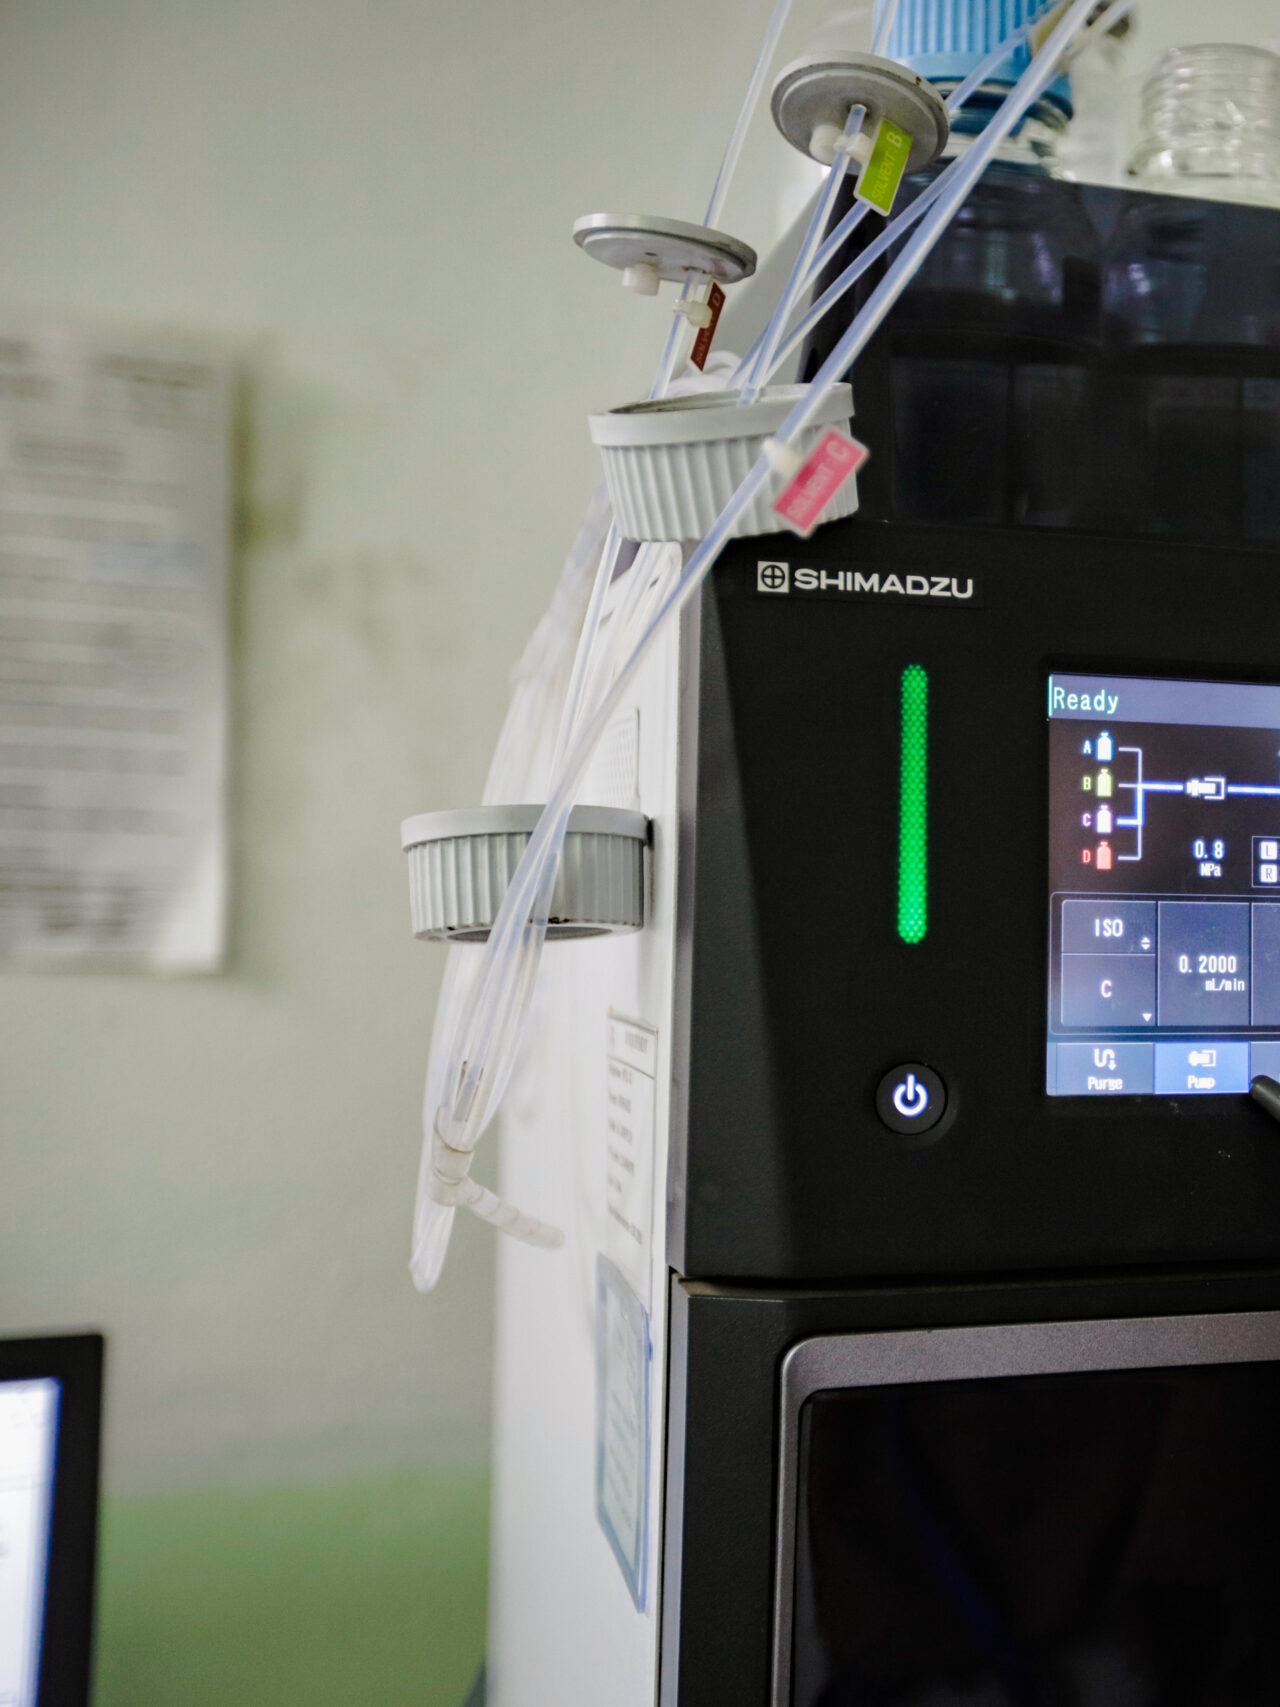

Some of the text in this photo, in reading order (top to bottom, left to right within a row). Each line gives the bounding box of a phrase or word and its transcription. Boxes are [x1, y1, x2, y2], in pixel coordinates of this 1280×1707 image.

[886, 131, 902, 147] B
[826, 440, 850, 462] C
[794, 568, 974, 599] SHIMADZU
[1053, 687, 1119, 714] Ready
[1083, 740, 1091, 754] A
[1083, 777, 1091, 791] B
[1082, 813, 1091, 827] C
[1082, 850, 1091, 864] D
[1193, 840, 1225, 860] 0.8
[1200, 863, 1222, 878] MPa
[1095, 918, 1123, 937] ISO
[1179, 955, 1237, 974] 0.2000
[1101, 980, 1112, 998] C
[1205, 978, 1245, 992] mL/min
[1088, 1077, 1123, 1091] Purge
[1188, 1075, 1215, 1089] Pump
